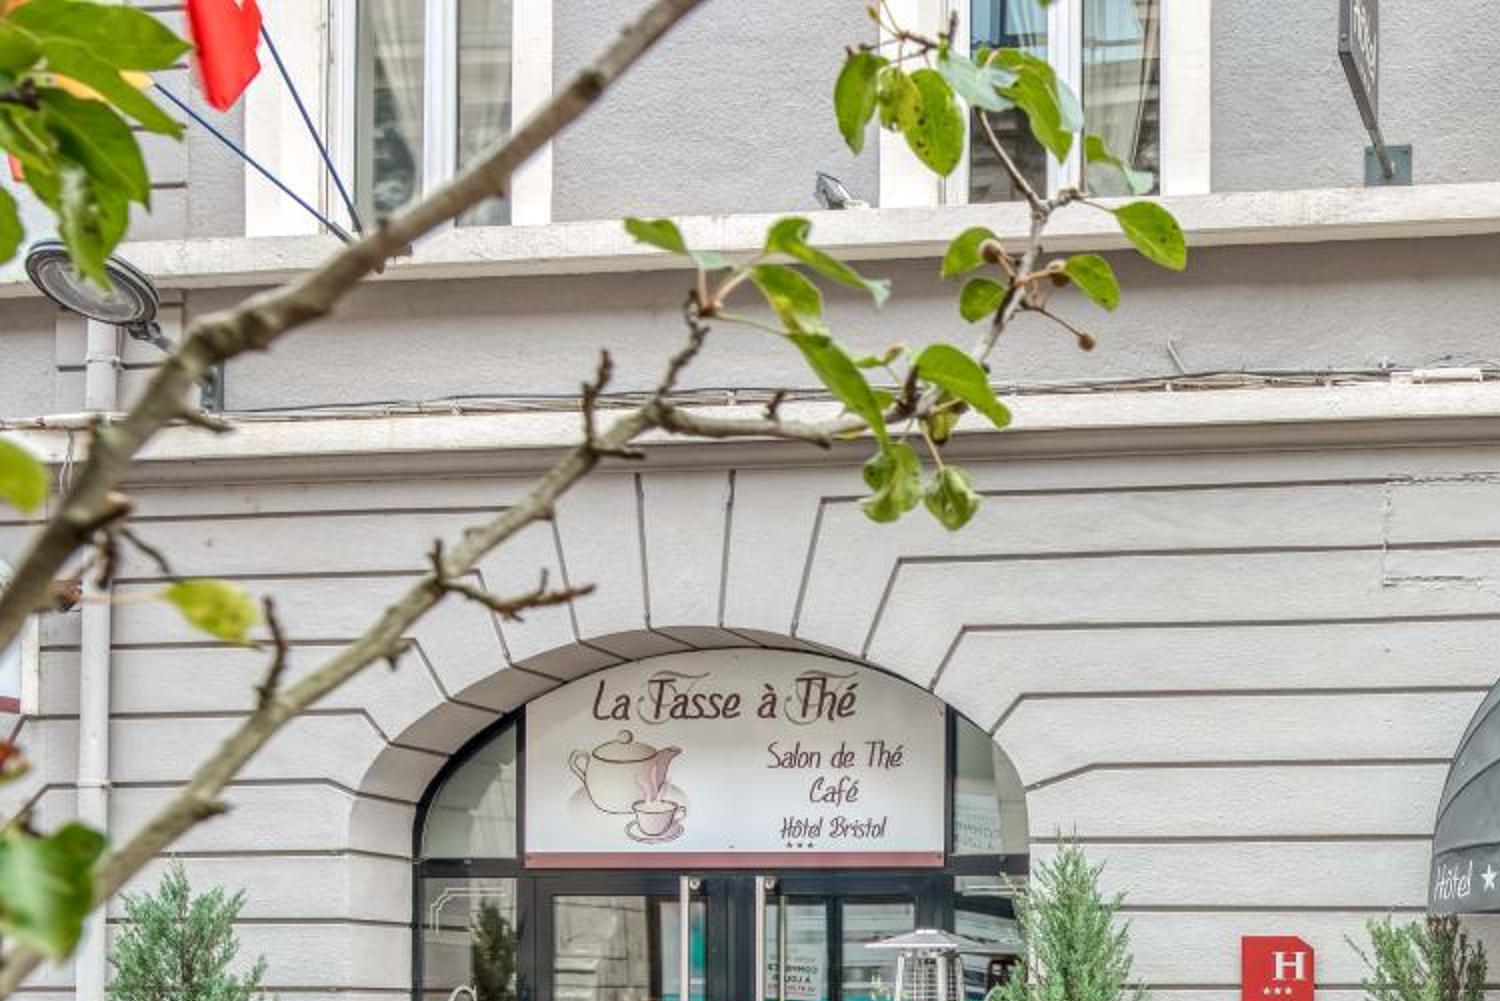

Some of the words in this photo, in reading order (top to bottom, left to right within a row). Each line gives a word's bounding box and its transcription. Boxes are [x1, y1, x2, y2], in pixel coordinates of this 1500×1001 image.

[592, 680, 630, 720] La
[641, 672, 741, 722] Tasse
[757, 683, 777, 720] à
[788, 672, 860, 722] Thé
[767, 741, 821, 769] Salon
[830, 742, 855, 768] de
[864, 741, 903, 769] Thé
[809, 777, 859, 806] Café
[781, 816, 823, 840] Hôtel
[829, 816, 887, 839] Bristol
[1433, 859, 1473, 901] Hôtel
[1272, 951, 1306, 981] H
